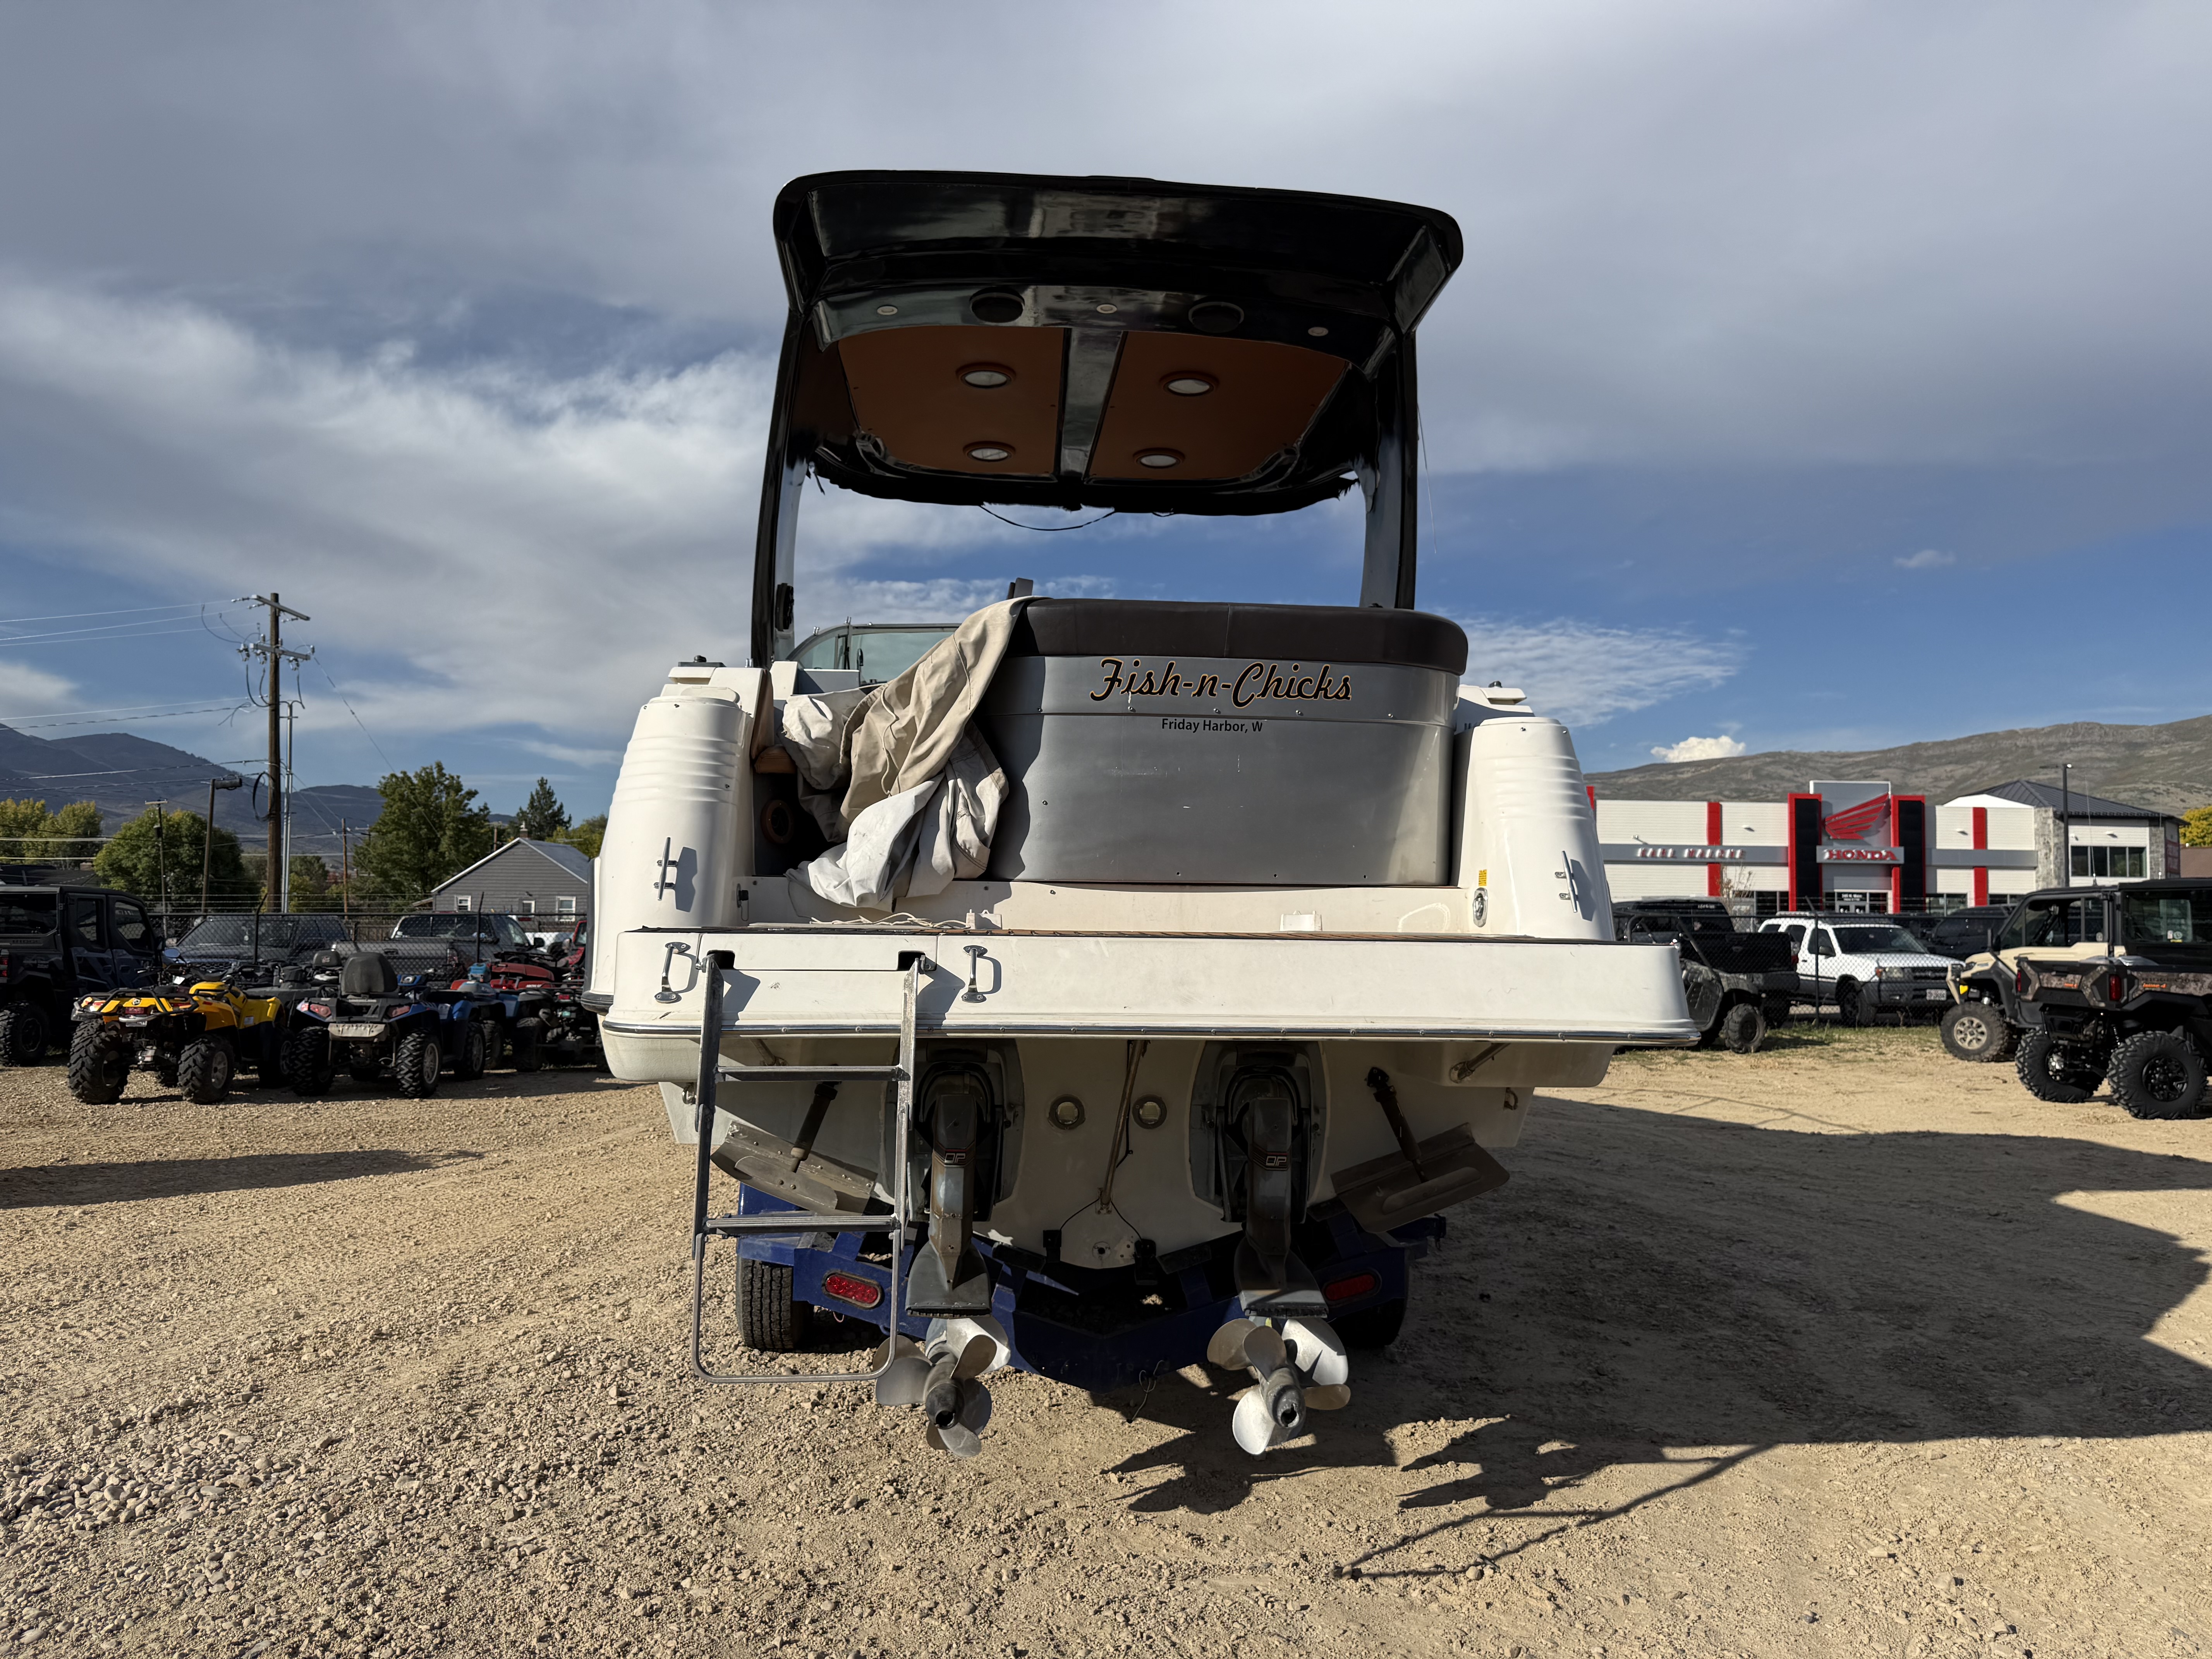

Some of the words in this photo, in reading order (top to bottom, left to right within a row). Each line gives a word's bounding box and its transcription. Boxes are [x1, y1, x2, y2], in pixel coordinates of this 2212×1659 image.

[1090, 657, 1352, 708] Fish-n-Chicks
[1162, 718, 1199, 733] Friday
[1202, 720, 1248, 733] Harbor,
[1824, 849, 1898, 860] HONDA
